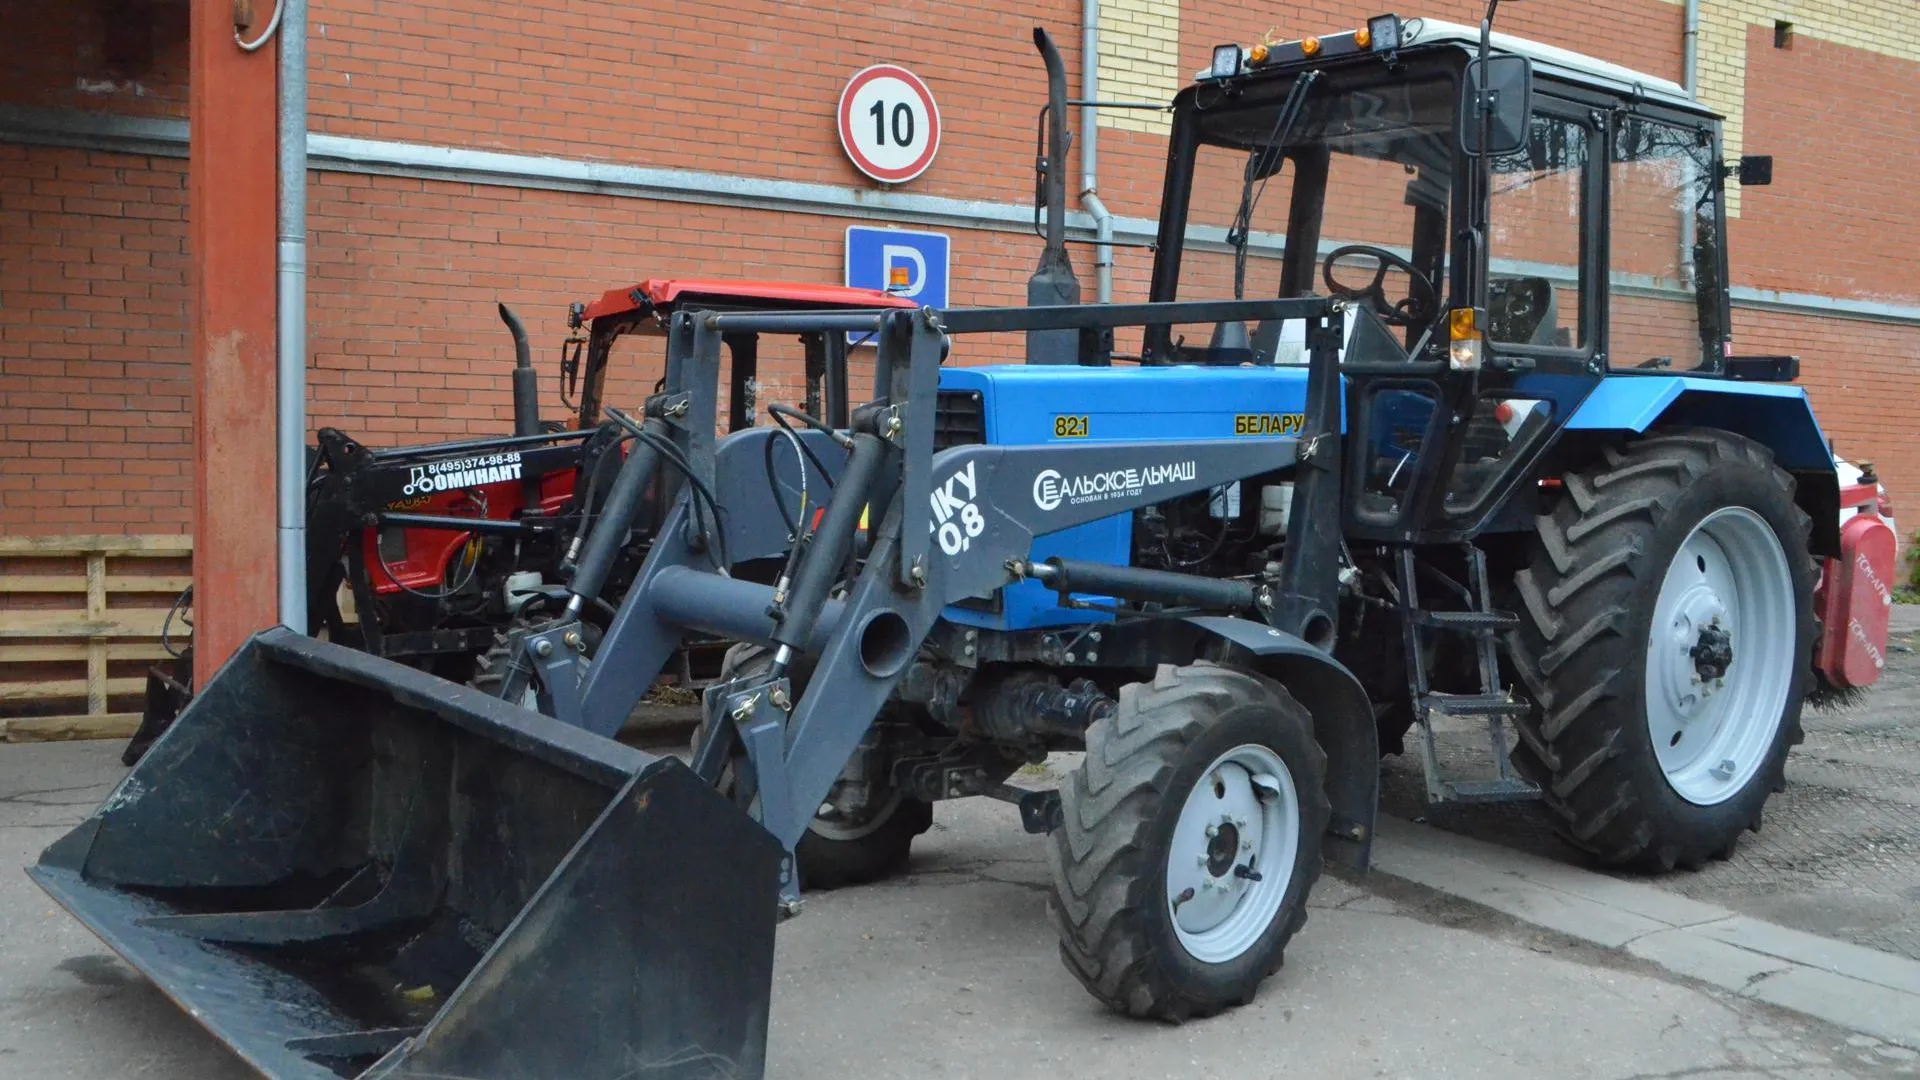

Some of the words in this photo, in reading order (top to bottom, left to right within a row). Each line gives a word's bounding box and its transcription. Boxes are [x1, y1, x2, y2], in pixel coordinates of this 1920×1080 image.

[869, 99, 915, 148] 10
[1055, 417, 1089, 437] 82.1
[1235, 414, 1305, 435] БЕЛАРУ
[428, 452, 521, 475] 8(495)374-98-88
[1070, 492, 1103, 505] ОСНОВАН
[1126, 488, 1144, 497] ГОДУ
[938, 503, 985, 556] 0,8
